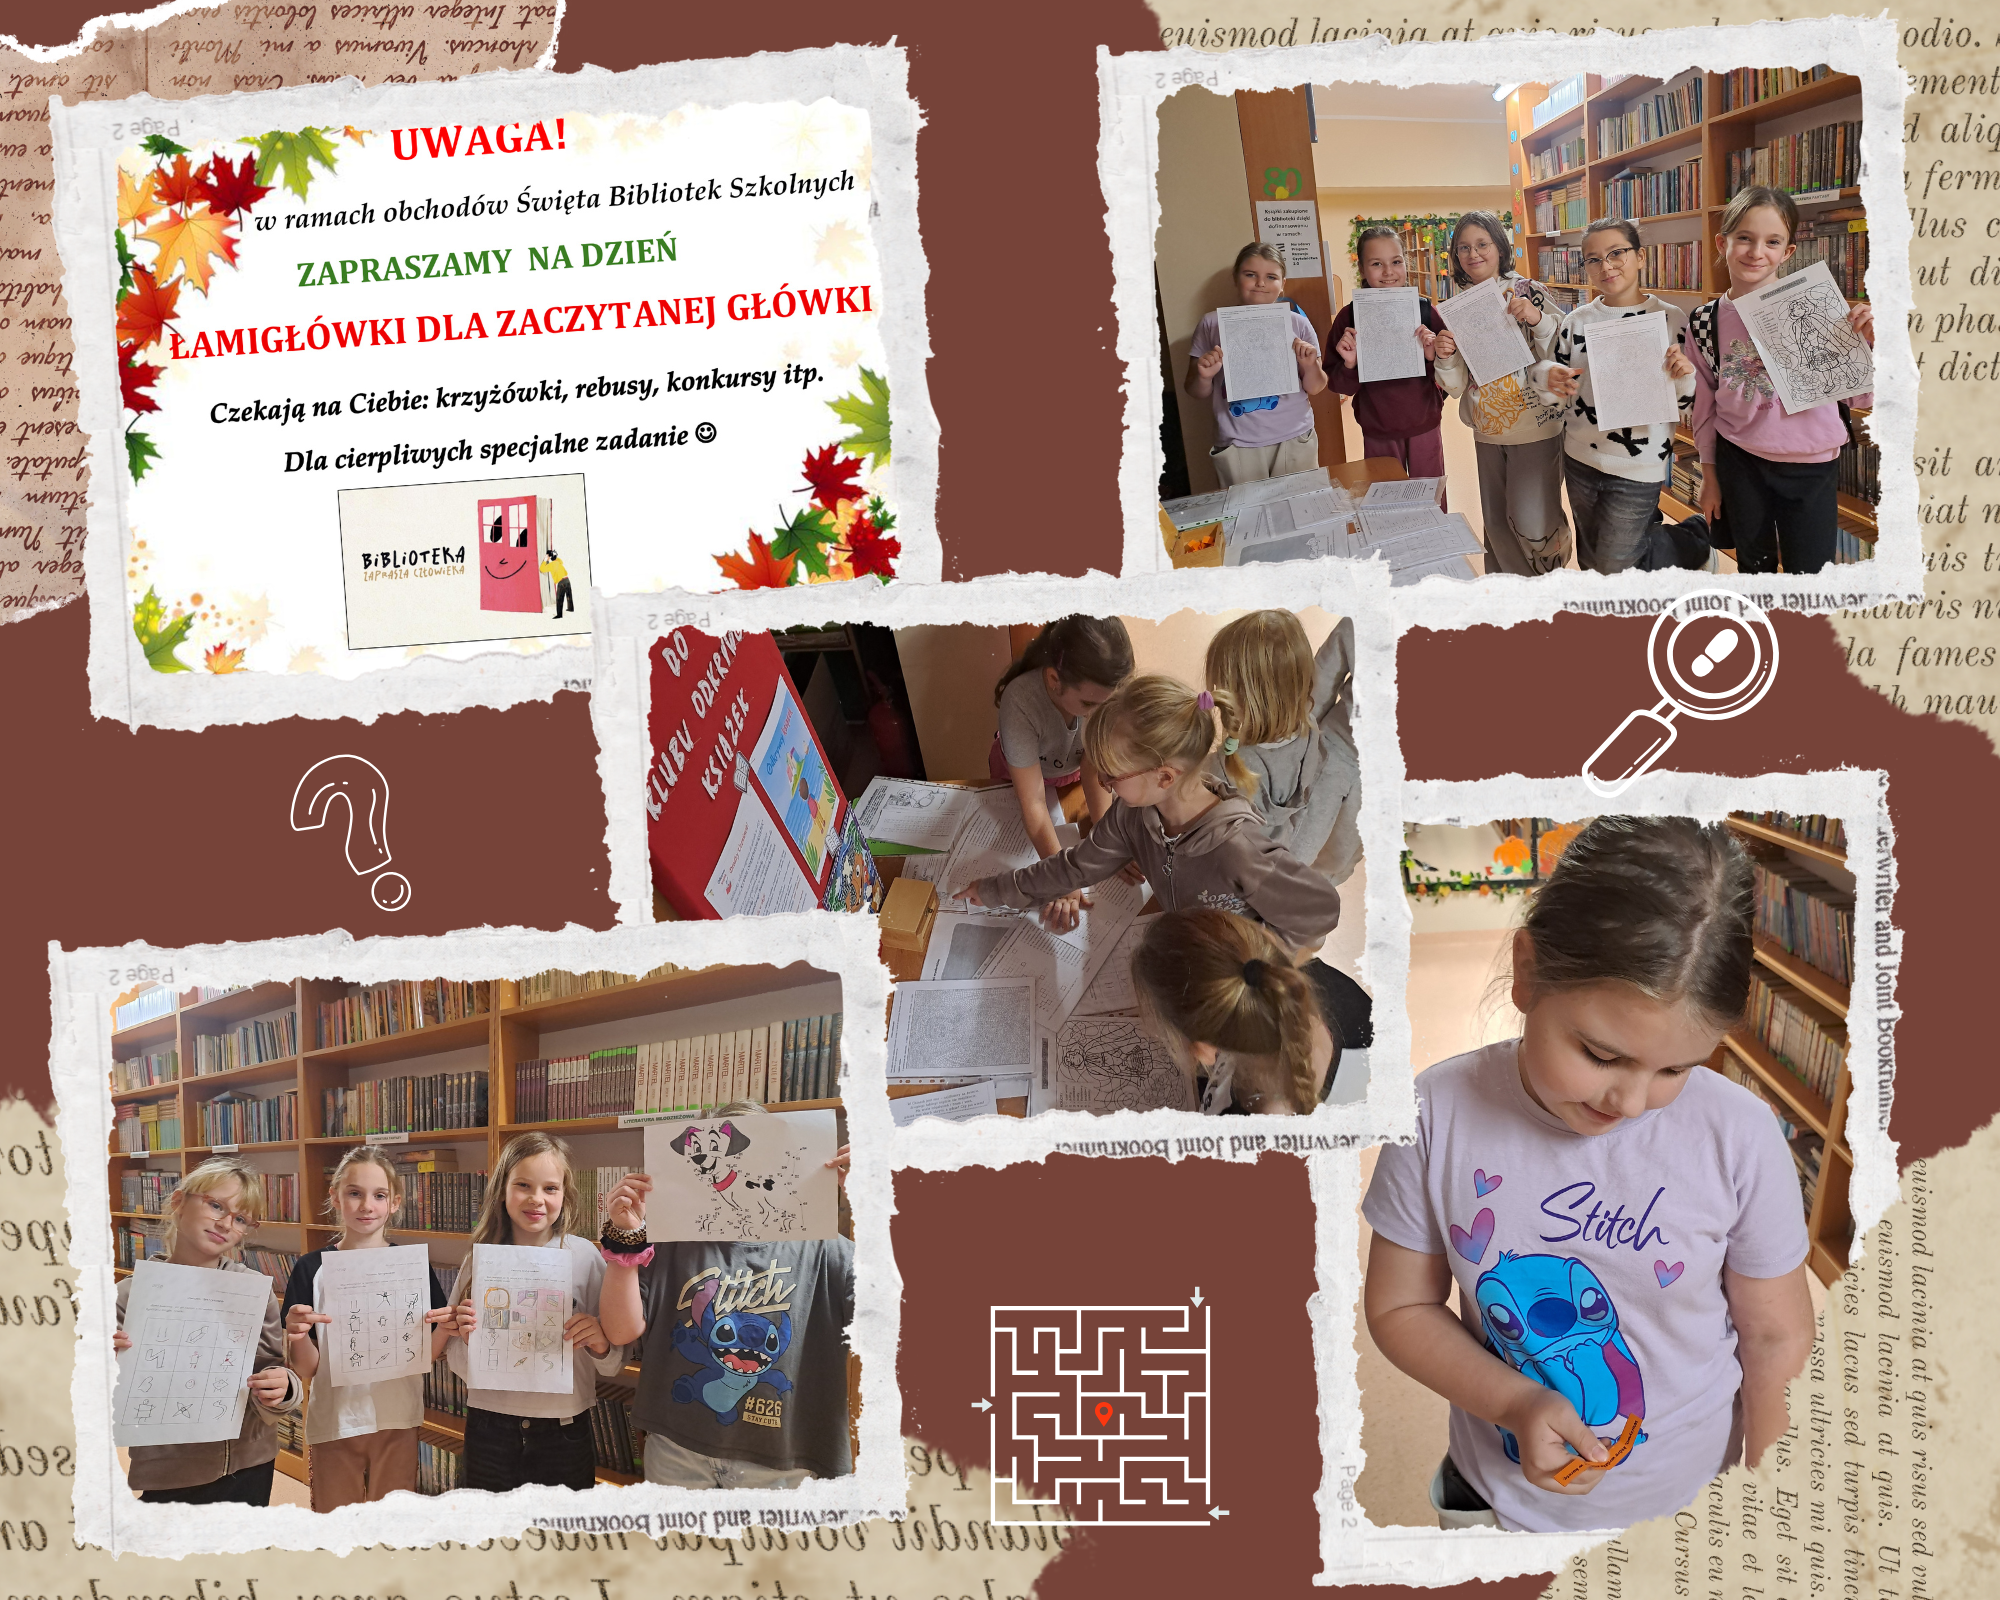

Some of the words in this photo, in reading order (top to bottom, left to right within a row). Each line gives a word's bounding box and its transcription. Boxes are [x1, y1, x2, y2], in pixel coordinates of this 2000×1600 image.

[234, 0, 317, 30] lobortis
[331, 2, 424, 30] ultrices
[433, 0, 511, 31] Integer
[305, 38, 321, 51] a
[1160, 17, 1298, 47] euismod
[1903, 17, 1981, 47] odio.
[170, 38, 242, 65] Morbi
[337, 38, 430, 65] Vivamus
[450, 38, 539, 64] rhoncus.
[76, 74, 117, 99] sit
[170, 76, 210, 89] non
[1156, 72, 1166, 88] 2
[1171, 67, 1219, 86] Page
[113, 122, 124, 140] 2
[126, 118, 180, 138] Page
[391, 117, 566, 161] UWAGA!
[1264, 167, 1302, 197] 80
[255, 215, 277, 231] w
[285, 202, 375, 229] ramach
[384, 194, 509, 223] obchodów
[516, 186, 601, 215] Święta
[609, 179, 722, 207] Bibliotek
[729, 169, 855, 200] Szkolnych
[297, 248, 513, 287] ZAPRASZAMY
[528, 245, 574, 271] NA
[582, 230, 678, 268] DZIEŃ
[1917, 256, 1951, 286] ut
[170, 315, 406, 360] ŁAMIGŁÓWKI
[416, 312, 489, 343] DLA
[496, 296, 716, 338] ZACZYTANEJ
[727, 283, 873, 321] GŁÓWKI
[1931, 303, 2000, 343] pha
[210, 398, 306, 426] Czekają
[313, 399, 342, 417] na
[349, 390, 429, 414] Ciebie:
[436, 380, 568, 413] krzyżówki,
[575, 375, 660, 401] rebusy,
[667, 368, 777, 396] konkursy
[783, 363, 824, 392] itp.
[284, 450, 327, 473] Dla
[335, 439, 473, 473] cierpliwych
[480, 433, 589, 465] specjalne
[596, 425, 689, 451] zadanie
[1914, 447, 1953, 476] sit
[1975, 456, 2000, 476] a
[647, 614, 658, 630] 2
[664, 609, 711, 629] Page
[662, 630, 688, 677] DO
[1896, 636, 1997, 676] fames
[647, 719, 694, 822] KLUBU
[1875, 920, 1899, 957] and
[109, 969, 119, 986] 2
[126, 964, 175, 983] Page
[1875, 963, 1898, 1011] Joint
[637, 1064, 645, 1087] MARTEL
[664, 1060, 672, 1084] MARTEL
[678, 1058, 686, 1082] MARTEL
[692, 1056, 700, 1082] MARTEL
[706, 1055, 714, 1080] MARTEL
[721, 1053, 729, 1079] MARTEL
[737, 1051, 745, 1078] MARTEL
[753, 1049, 762, 1075] MARTEL
[623, 1116, 655, 1124] LITERATURA
[1177, 1136, 1224, 1159] Joint
[1230, 1134, 1267, 1159] and
[1540, 1182, 1669, 1252] Stitch
[1911, 1158, 1933, 1257] euismod
[1878, 1219, 1900, 1319] euismod
[676, 1259, 797, 1313] Stitch
[1911, 1264, 1933, 1350] lacinia
[1844, 1332, 1866, 1394] lacus
[1878, 1334, 1900, 1418] lacinia
[1911, 1358, 1933, 1382] at
[744, 1397, 783, 1417] #626
[747, 1414, 763, 1423] STAY
[763, 1415, 778, 1425] CUTE
[1905, 1391, 1933, 1441] quis
[1810, 1393, 1832, 1491] ultricies
[1844, 1408, 1866, 1447] sed
[1878, 1431, 1899, 1456] at
[1337, 1465, 1357, 1512] Page
[1911, 1449, 1933, 1510] risus
[1742, 1481, 1764, 1540] vitae
[1837, 1461, 1865, 1535] turpis
[1872, 1471, 1899, 1528] quis.
[657, 1510, 708, 1533] Joint
[713, 1509, 751, 1534] and
[1341, 1517, 1357, 1528] 2
[1770, 1487, 1799, 1541] Eget
[1810, 1500, 1831, 1534] mi
[1911, 1518, 1933, 1557] sed
[1674, 1511, 1697, 1597] Cursus
[1709, 1555, 1723, 1582] eu
[1742, 1553, 1764, 1572] et
[1777, 1553, 1798, 1585] sit
[1878, 1545, 1900, 1575] Ut
[1804, 1543, 1831, 1598] quis.
